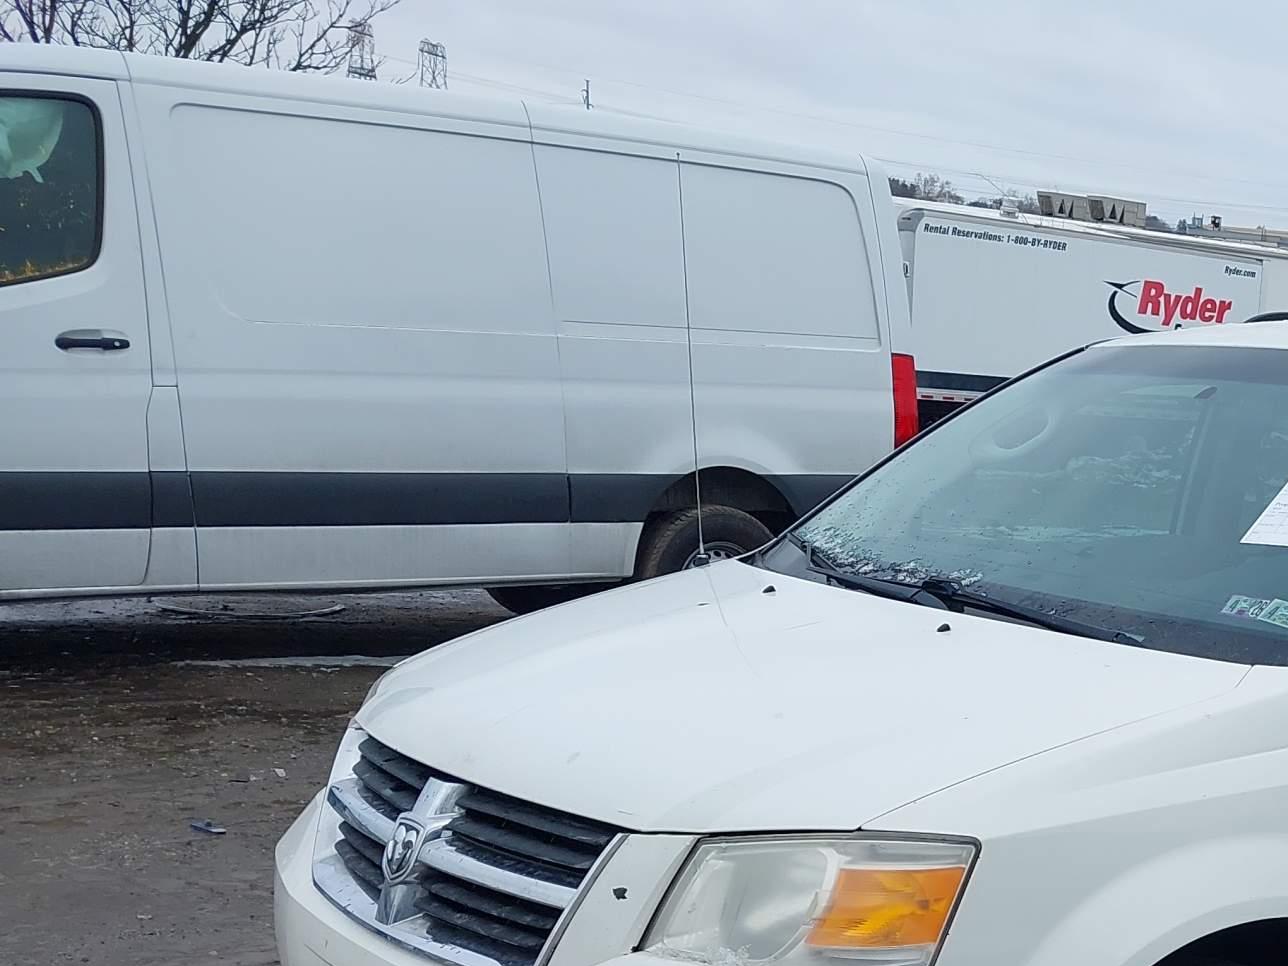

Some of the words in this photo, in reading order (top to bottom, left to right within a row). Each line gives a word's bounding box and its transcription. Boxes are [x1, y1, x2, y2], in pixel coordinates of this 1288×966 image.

[924, 223, 950, 236] Rental
[951, 227, 1005, 243] Reservations:
[1006, 234, 1068, 252] 1-800-BY-RYDER
[1224, 265, 1256, 279] Ryder.com
[1138, 279, 1233, 326] Ryder
